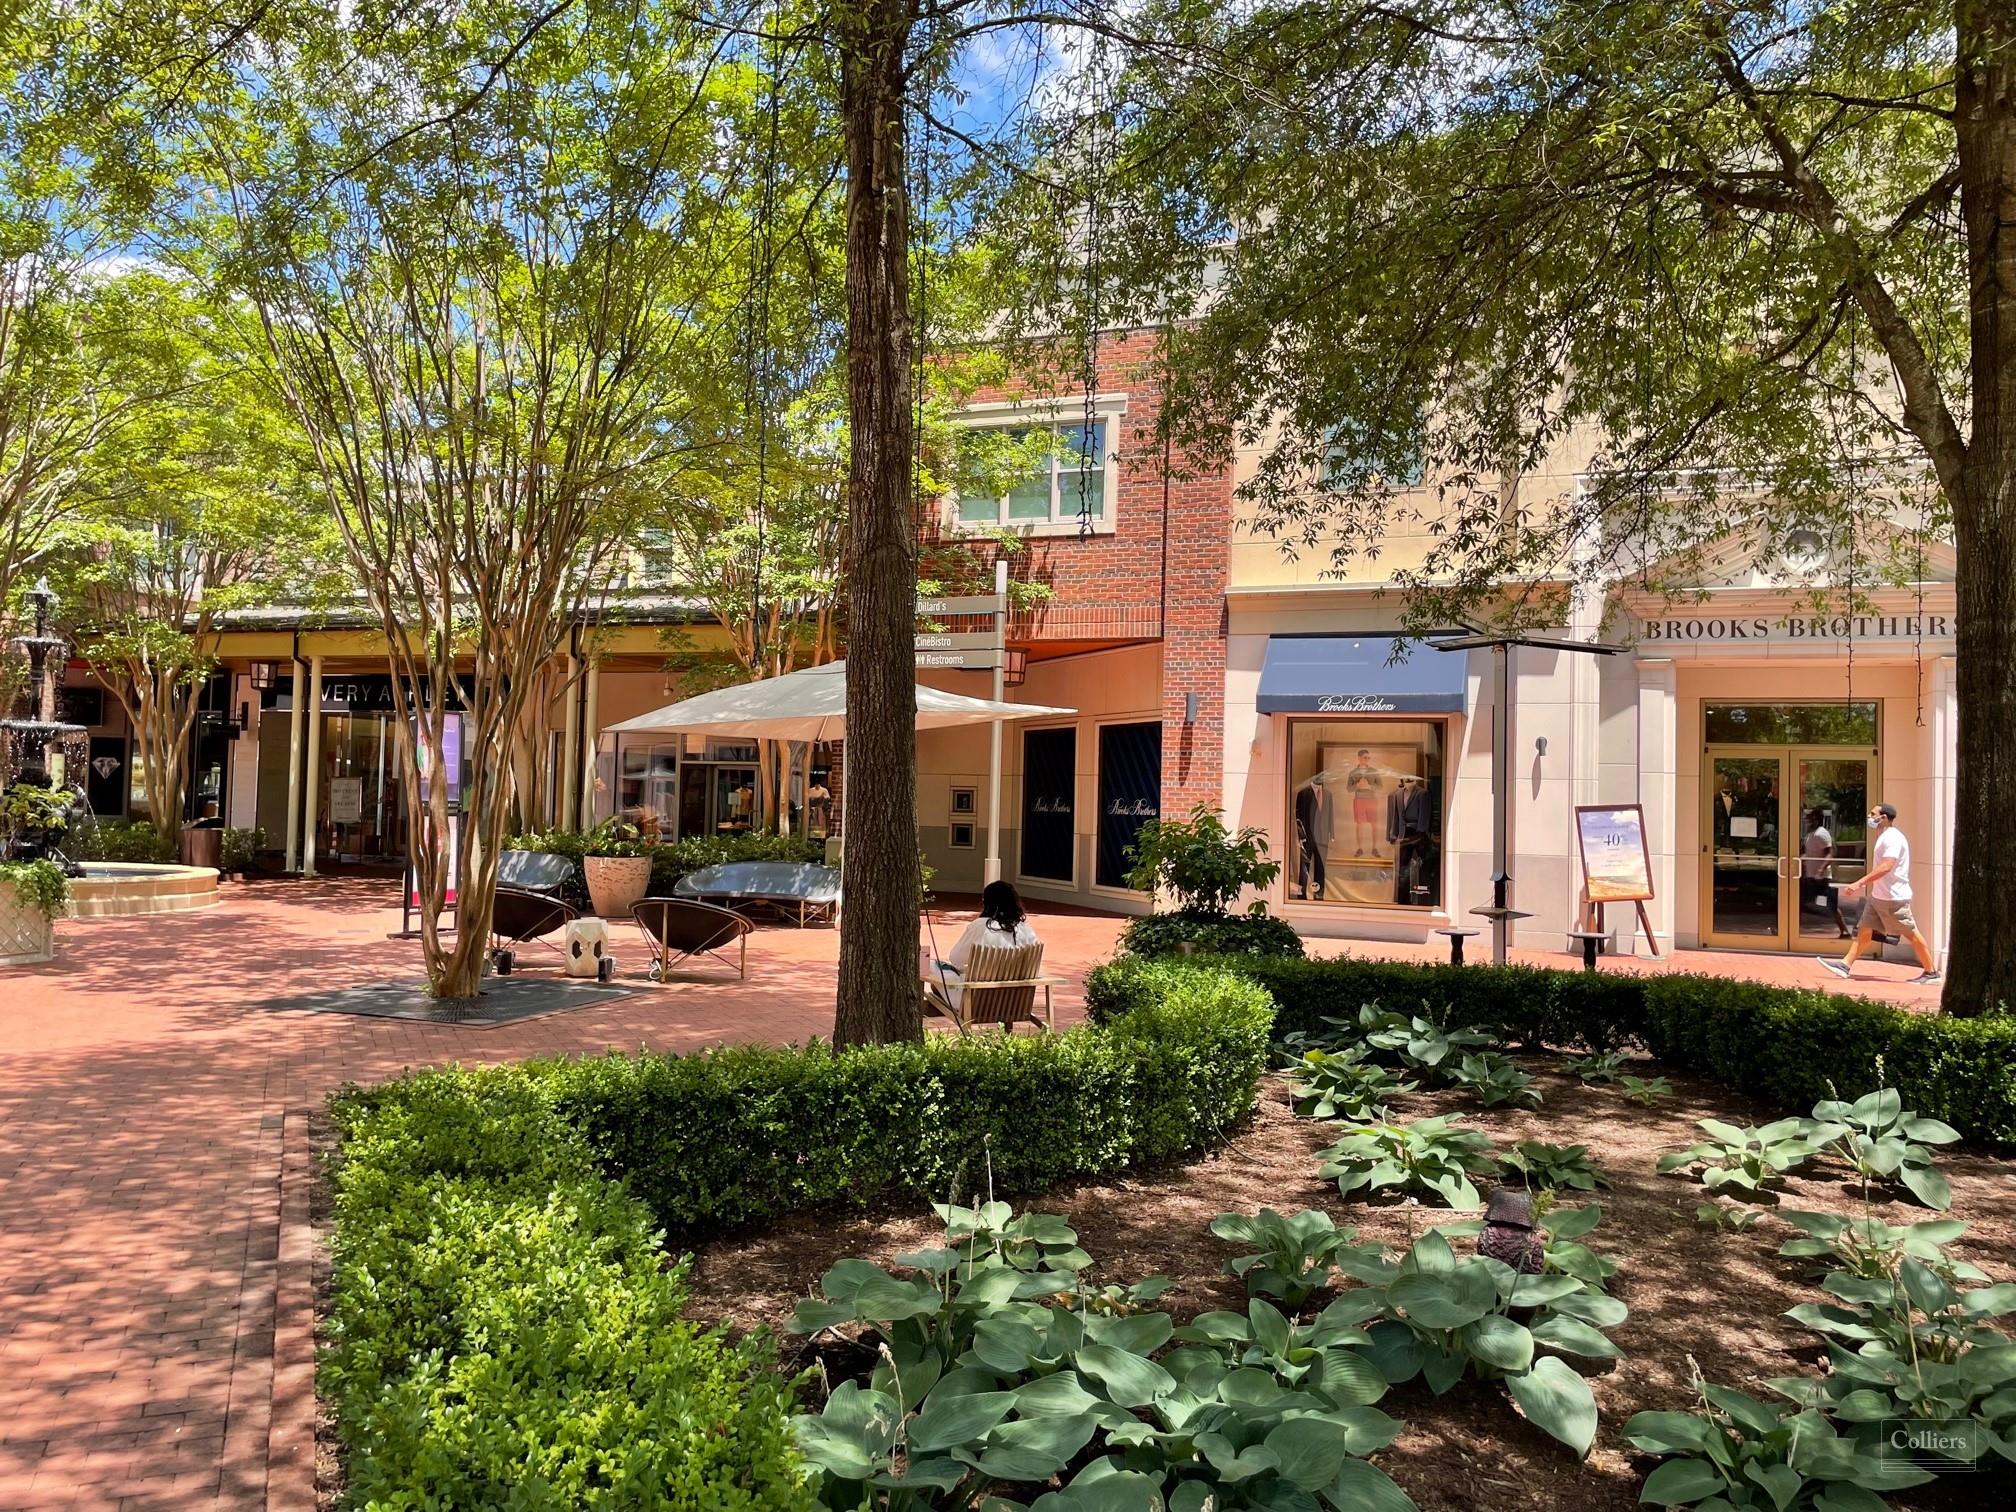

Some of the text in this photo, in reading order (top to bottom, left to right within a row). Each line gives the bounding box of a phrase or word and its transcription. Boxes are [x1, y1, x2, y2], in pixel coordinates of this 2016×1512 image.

[917, 601, 947, 612] Dillard's
[1646, 615, 1957, 639] BROOKS BROTHER
[915, 635, 952, 647] CinéBistro
[926, 654, 964, 665] Restrooms
[1317, 694, 1396, 711] Brooks Brothers
